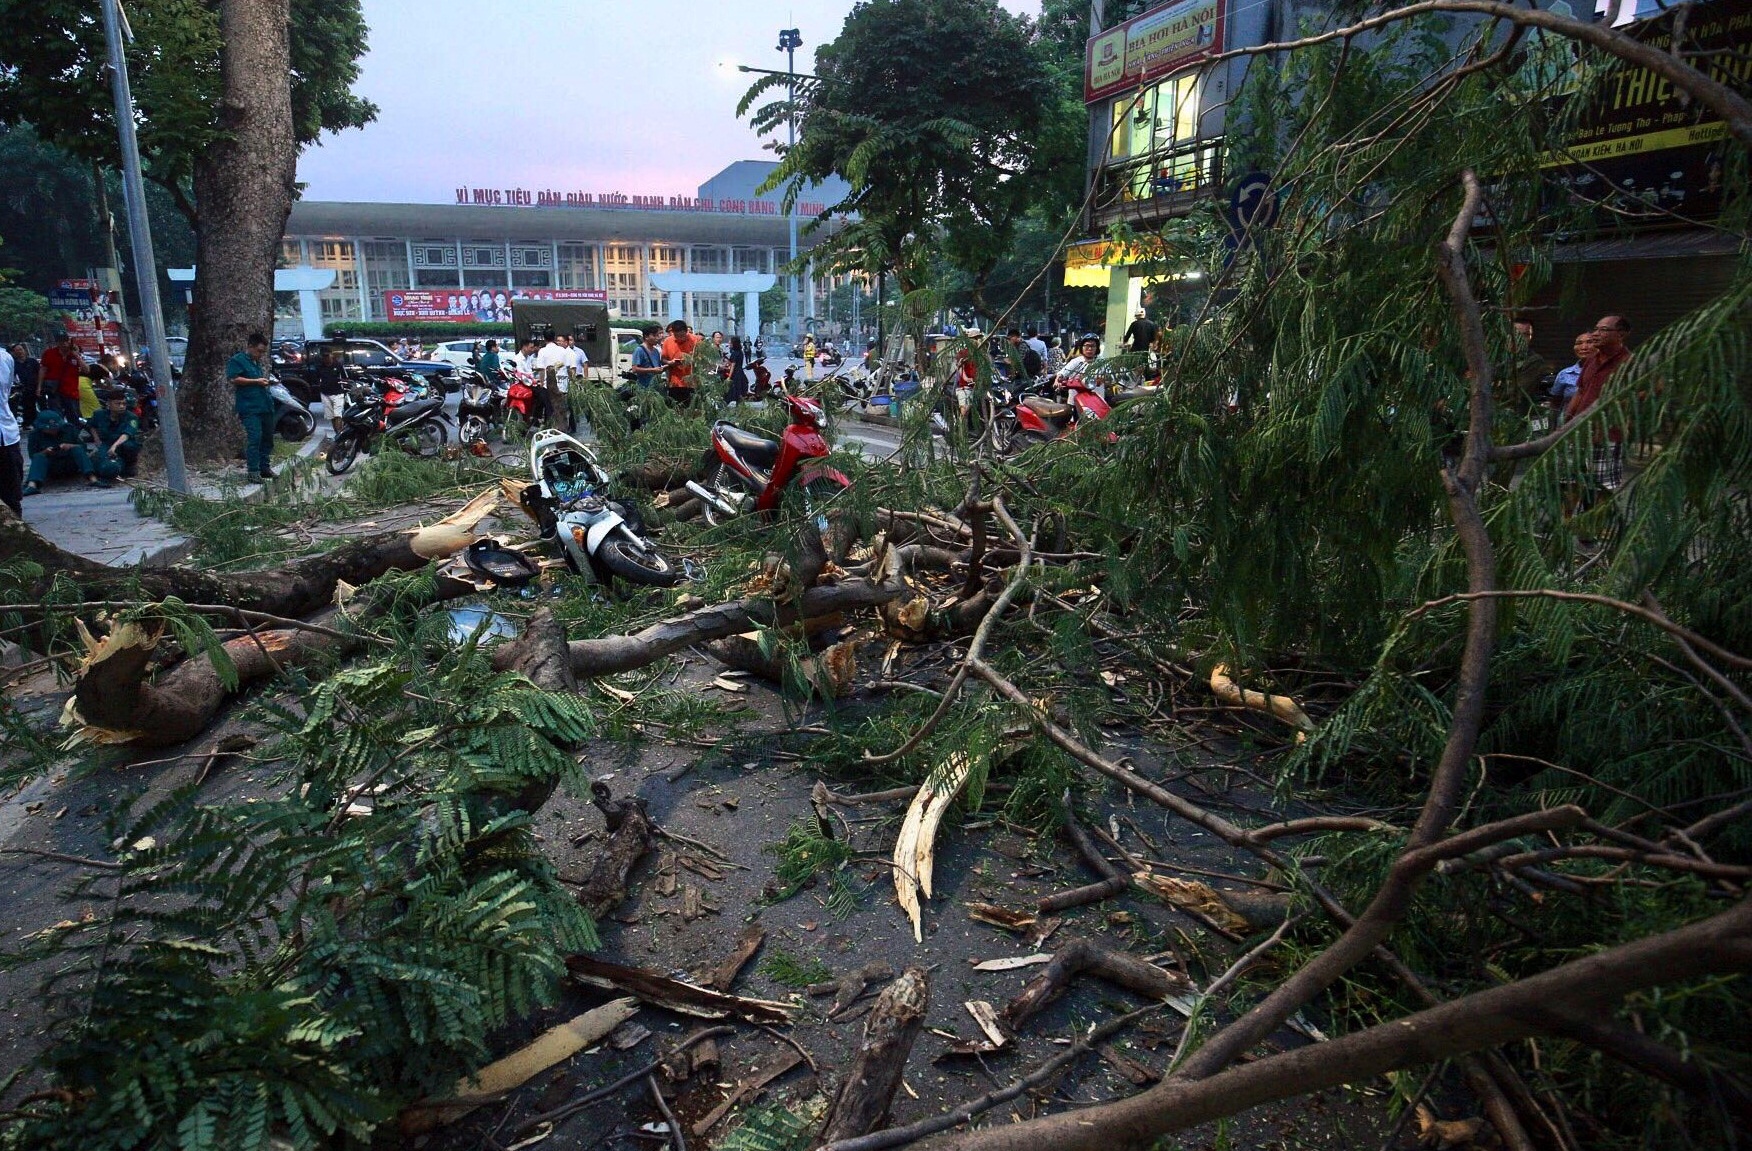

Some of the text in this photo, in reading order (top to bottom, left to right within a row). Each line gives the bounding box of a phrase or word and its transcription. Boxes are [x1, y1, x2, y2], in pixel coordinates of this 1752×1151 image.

[1128, 38, 1146, 53] BIA
[1172, 17, 1189, 34] HÀ
[455, 186, 469, 204] VÌ
[473, 188, 502, 206] MỤC
[505, 187, 532, 205] TIÊU
[538, 189, 561, 207] DÂN
[598, 191, 628, 209] NƯỚC
[670, 194, 692, 211] DÂN
[720, 197, 746, 214] CÔNG
[800, 202, 825, 216] MINH
